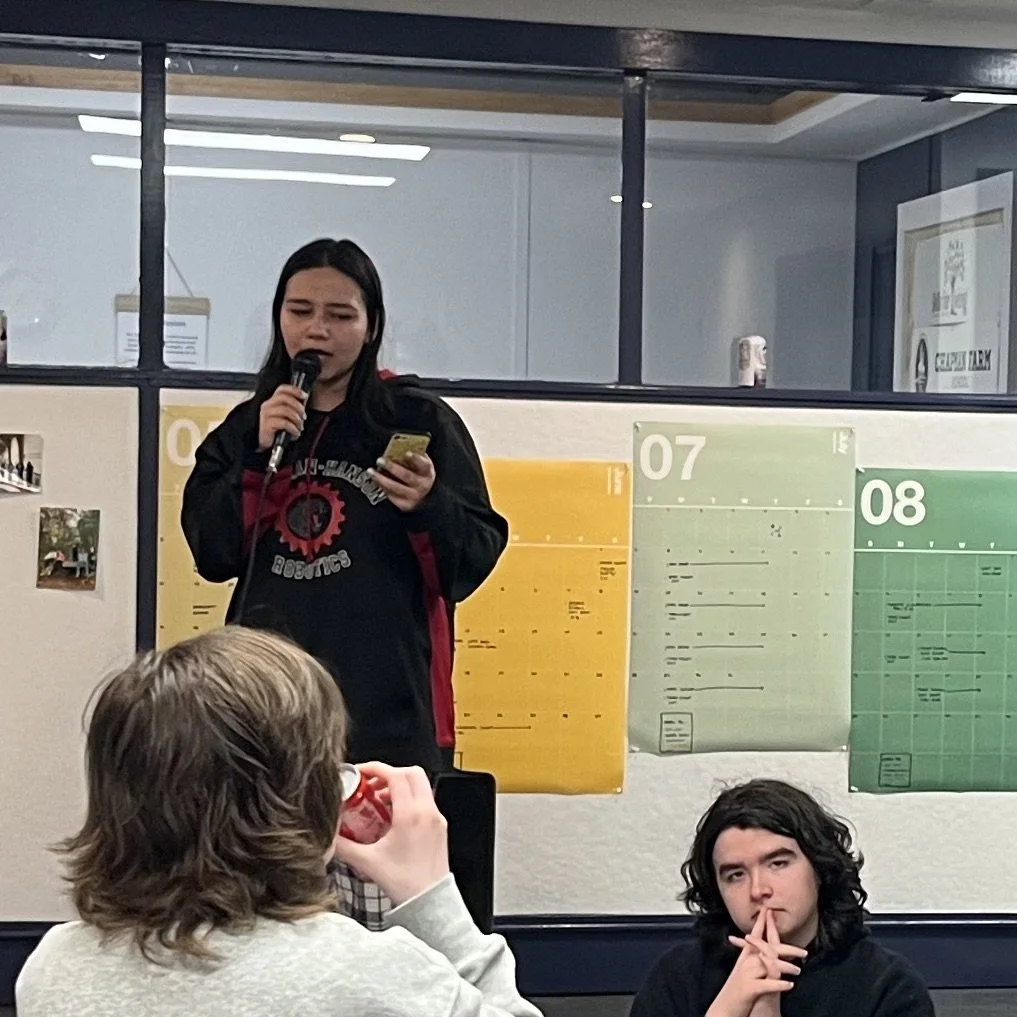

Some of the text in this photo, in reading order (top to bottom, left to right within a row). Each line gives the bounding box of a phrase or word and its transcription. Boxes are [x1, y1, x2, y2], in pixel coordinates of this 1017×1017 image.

[167, 418, 223, 466] 0
[639, 434, 706, 480] 07
[860, 478, 926, 526] 08
[271, 549, 352, 580] ROBOTICS
